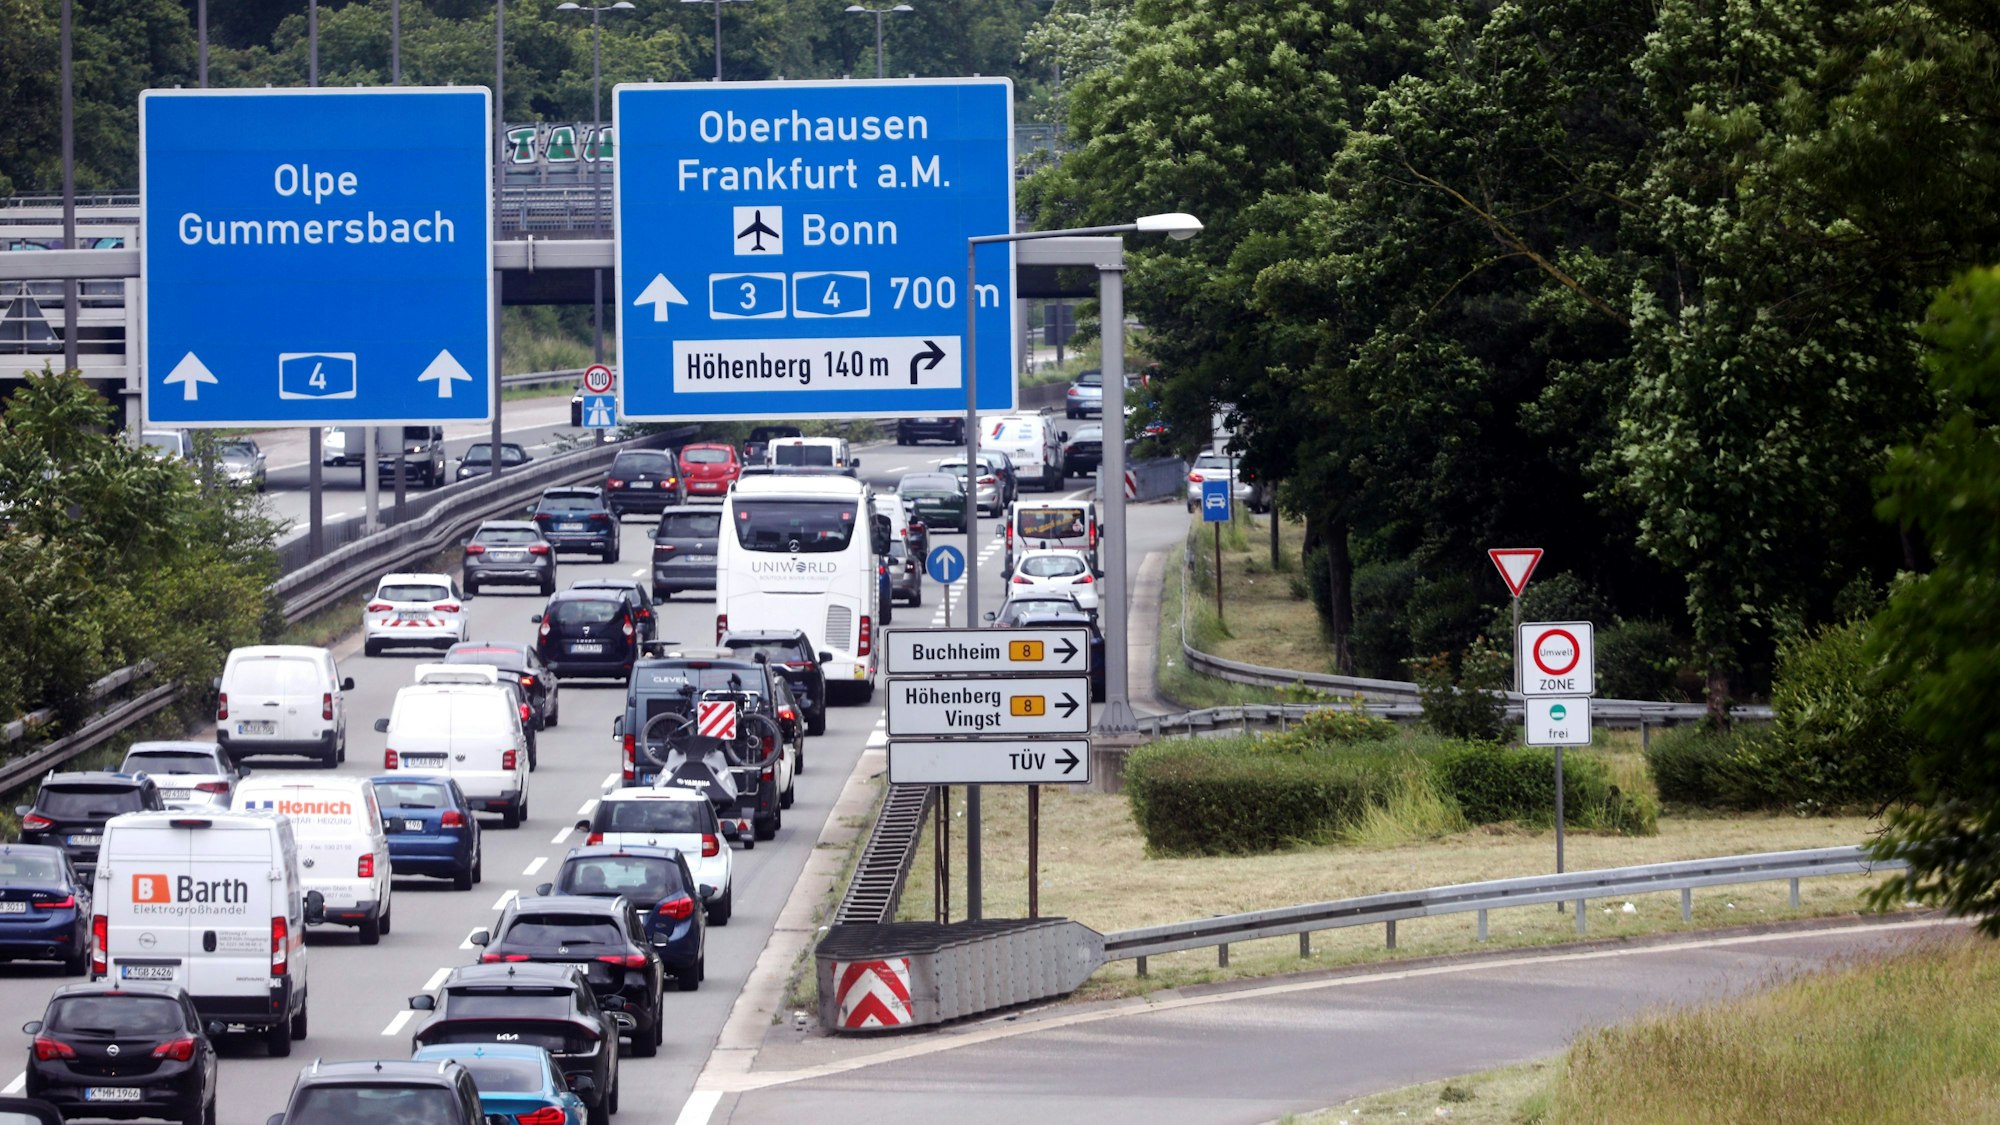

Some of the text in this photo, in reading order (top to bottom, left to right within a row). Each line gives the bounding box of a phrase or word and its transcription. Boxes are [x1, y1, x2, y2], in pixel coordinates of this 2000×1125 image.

[699, 109, 928, 144] Oberhausen
[274, 163, 358, 204] Olpe
[677, 155, 951, 191] Frankfurt a.M.
[178, 210, 455, 246] Gummersbach
[802, 213, 898, 246] Bonn
[739, 282, 757, 310] 3
[822, 280, 841, 308] 4
[889, 275, 956, 310] 700
[308, 361, 327, 390] 4
[686, 352, 811, 385] Höhenberg
[823, 350, 863, 378] 140
[589, 372, 608, 386] 100
[912, 642, 1031, 661] Buchheim 8
[1539, 648, 1573, 657] Umwelt
[1539, 678, 1575, 691] ZONE
[905, 686, 1001, 708] Höhenberg
[1023, 699, 1032, 713] 8
[945, 709, 1001, 730] Vingst
[1548, 728, 1569, 739] frei
[1008, 748, 1046, 770] TÜV
[684, 778, 711, 787] YAMAHA
[278, 799, 352, 815] Henrich
[177, 875, 248, 904] Barth
[133, 903, 247, 917] Elektrogroßhandel
